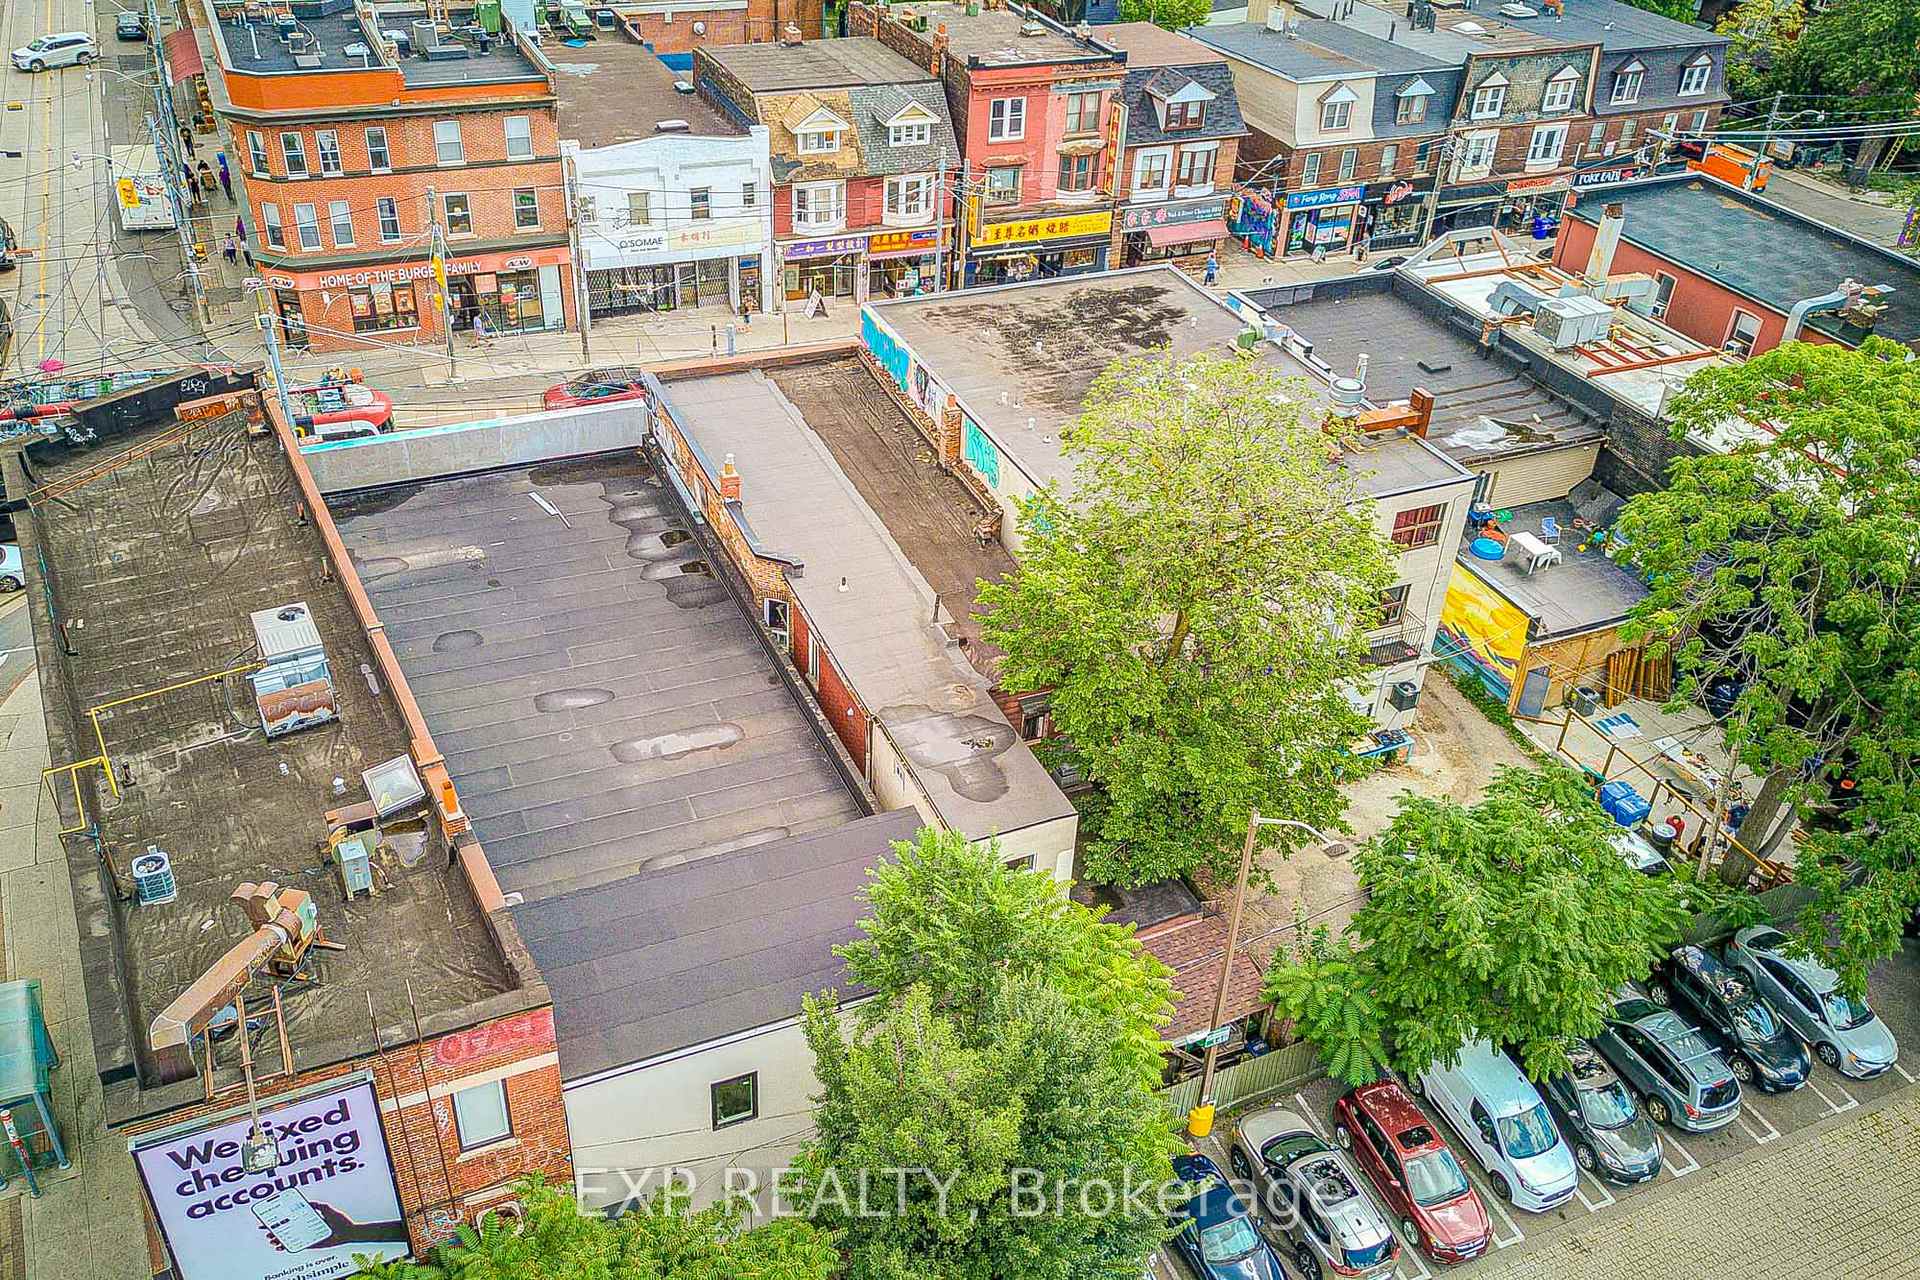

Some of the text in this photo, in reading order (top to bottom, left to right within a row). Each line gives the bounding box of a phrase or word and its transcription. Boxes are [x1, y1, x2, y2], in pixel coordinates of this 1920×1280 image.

[319, 261, 482, 288] HOME OF THE BURGE FAMILY
[166, 1138, 240, 1171] We
[186, 1155, 366, 1220] accounts.
[264, 1265, 304, 1280] Banking
[315, 1255, 339, 1266] over.
